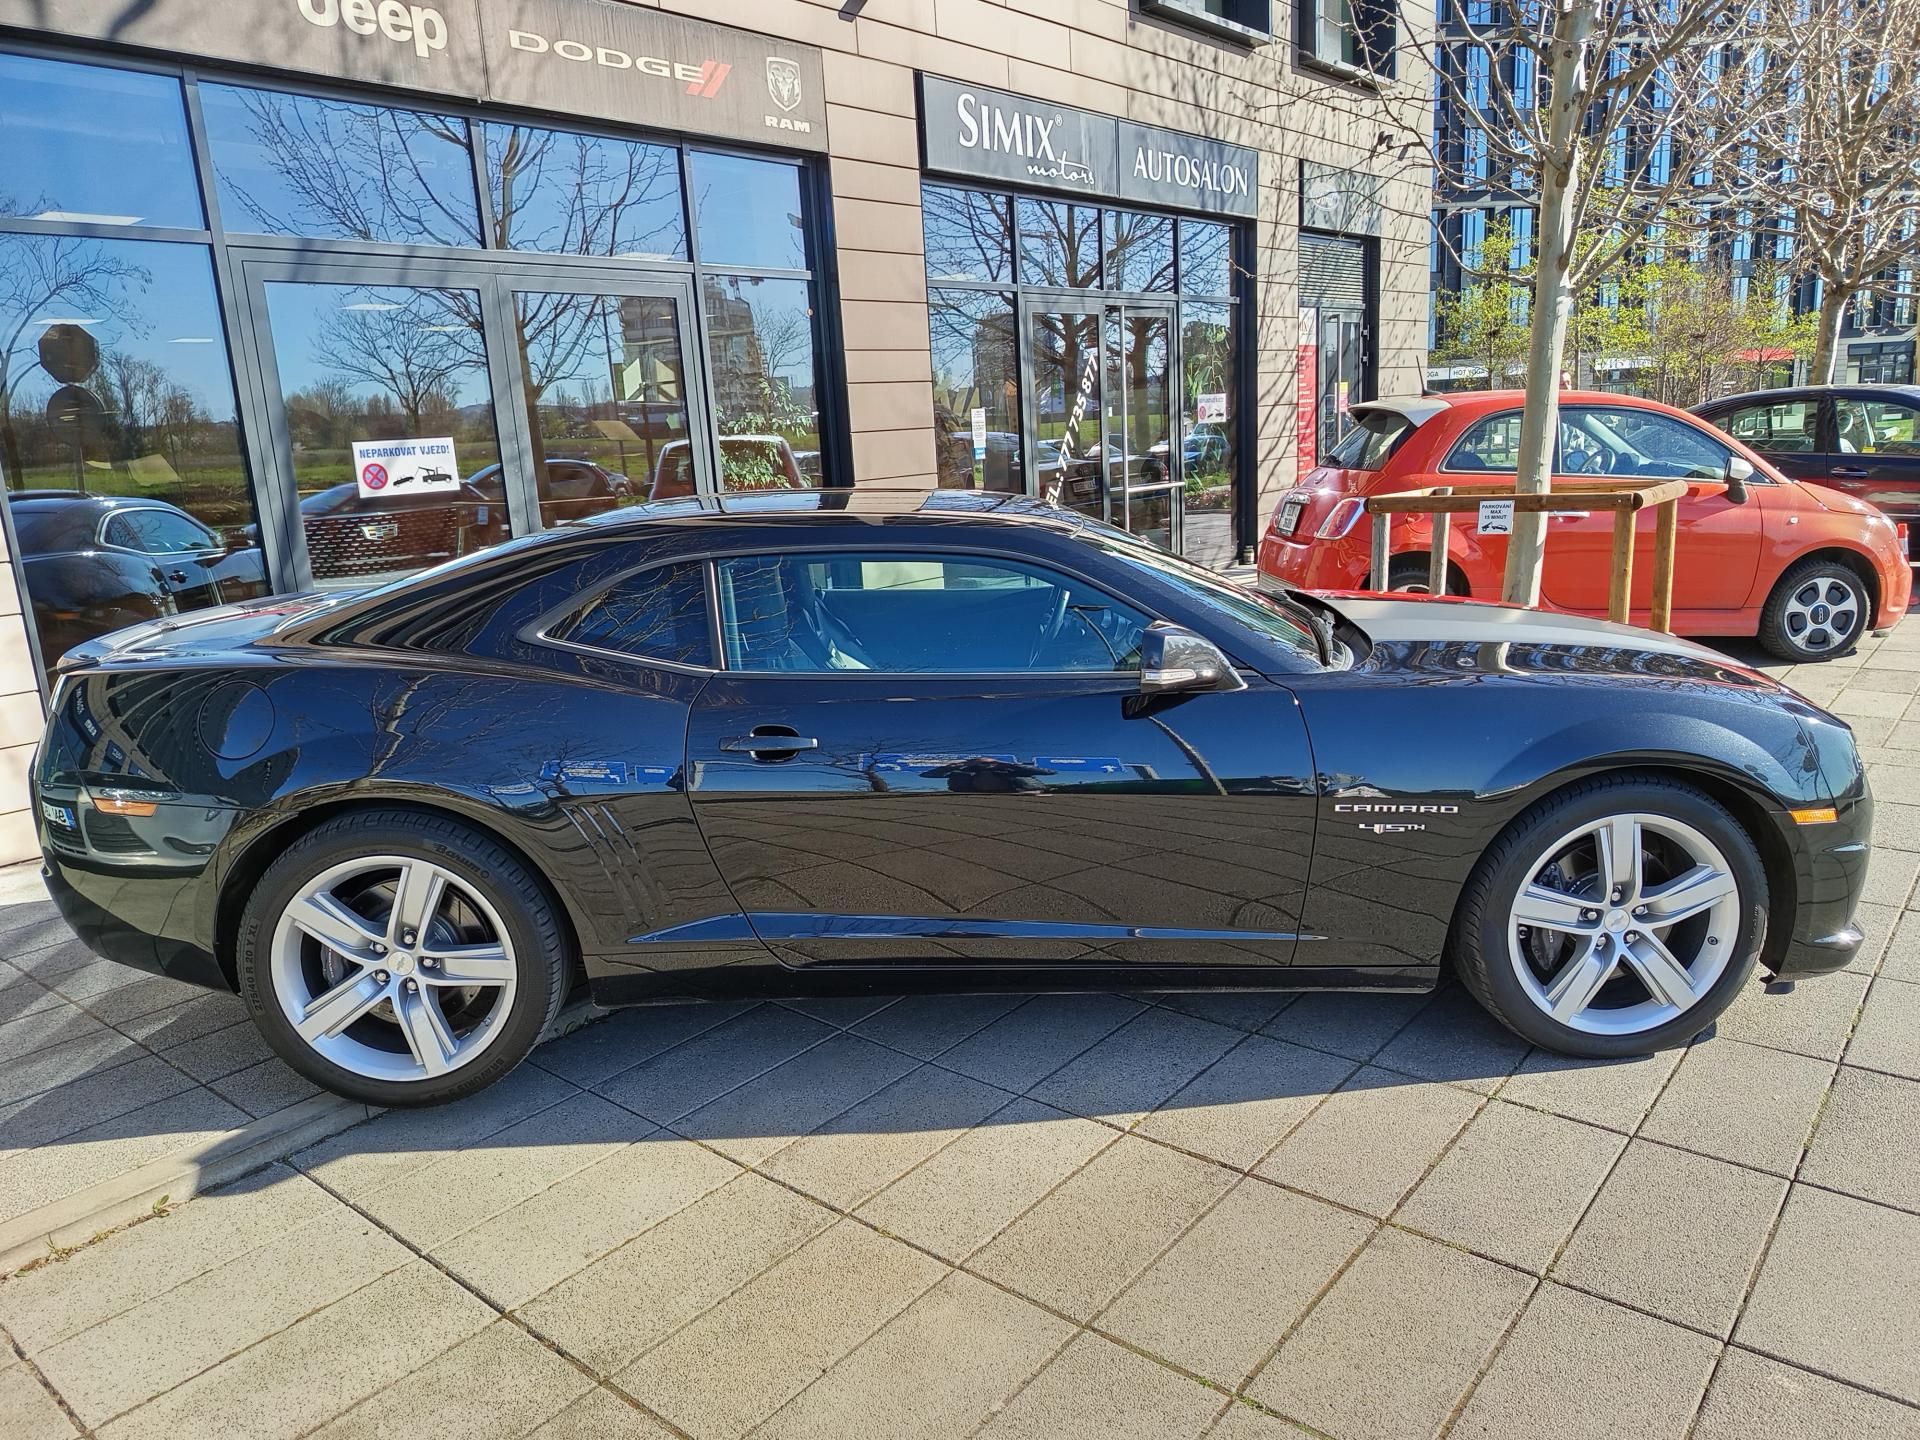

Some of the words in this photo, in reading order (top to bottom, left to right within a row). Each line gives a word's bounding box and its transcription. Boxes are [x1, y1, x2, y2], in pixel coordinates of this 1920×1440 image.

[508, 29, 705, 84] DODGE
[764, 115, 811, 133] RAM
[1026, 150, 1095, 185] motors
[1133, 146, 1249, 197] AUTOSALON
[1057, 430, 1075, 472] 777
[1068, 391, 1087, 432] 735
[1081, 353, 1098, 394] 877
[359, 446, 417, 459] NEPARKOVAT
[419, 445, 450, 456] VJEZD!
[1334, 804, 1459, 814] CAMARO
[245, 950, 254, 964] 20
